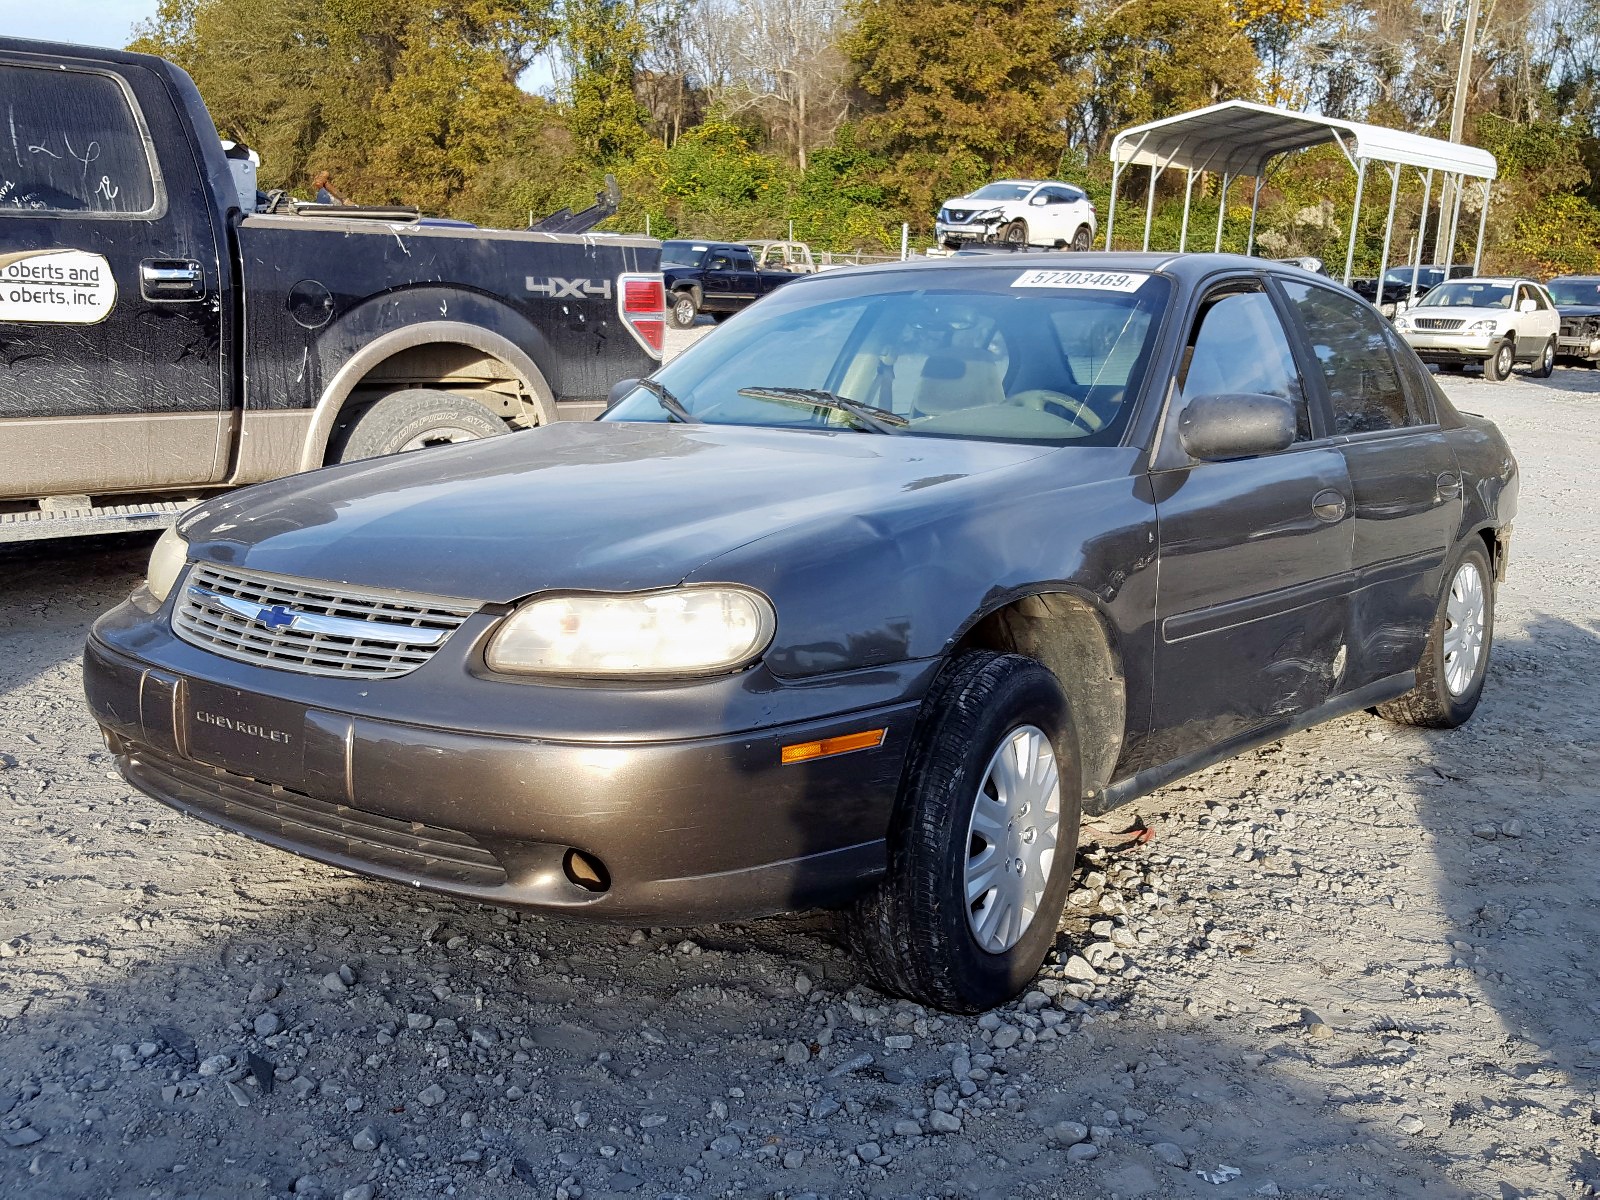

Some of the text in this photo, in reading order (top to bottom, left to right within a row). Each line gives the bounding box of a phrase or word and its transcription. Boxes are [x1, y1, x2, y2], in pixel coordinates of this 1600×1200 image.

[0, 262, 99, 282] oberts and
[1030, 271, 1130, 287] 57203469
[0, 287, 101, 306] oberts, inc.
[196, 710, 292, 744] CHEVROLET
